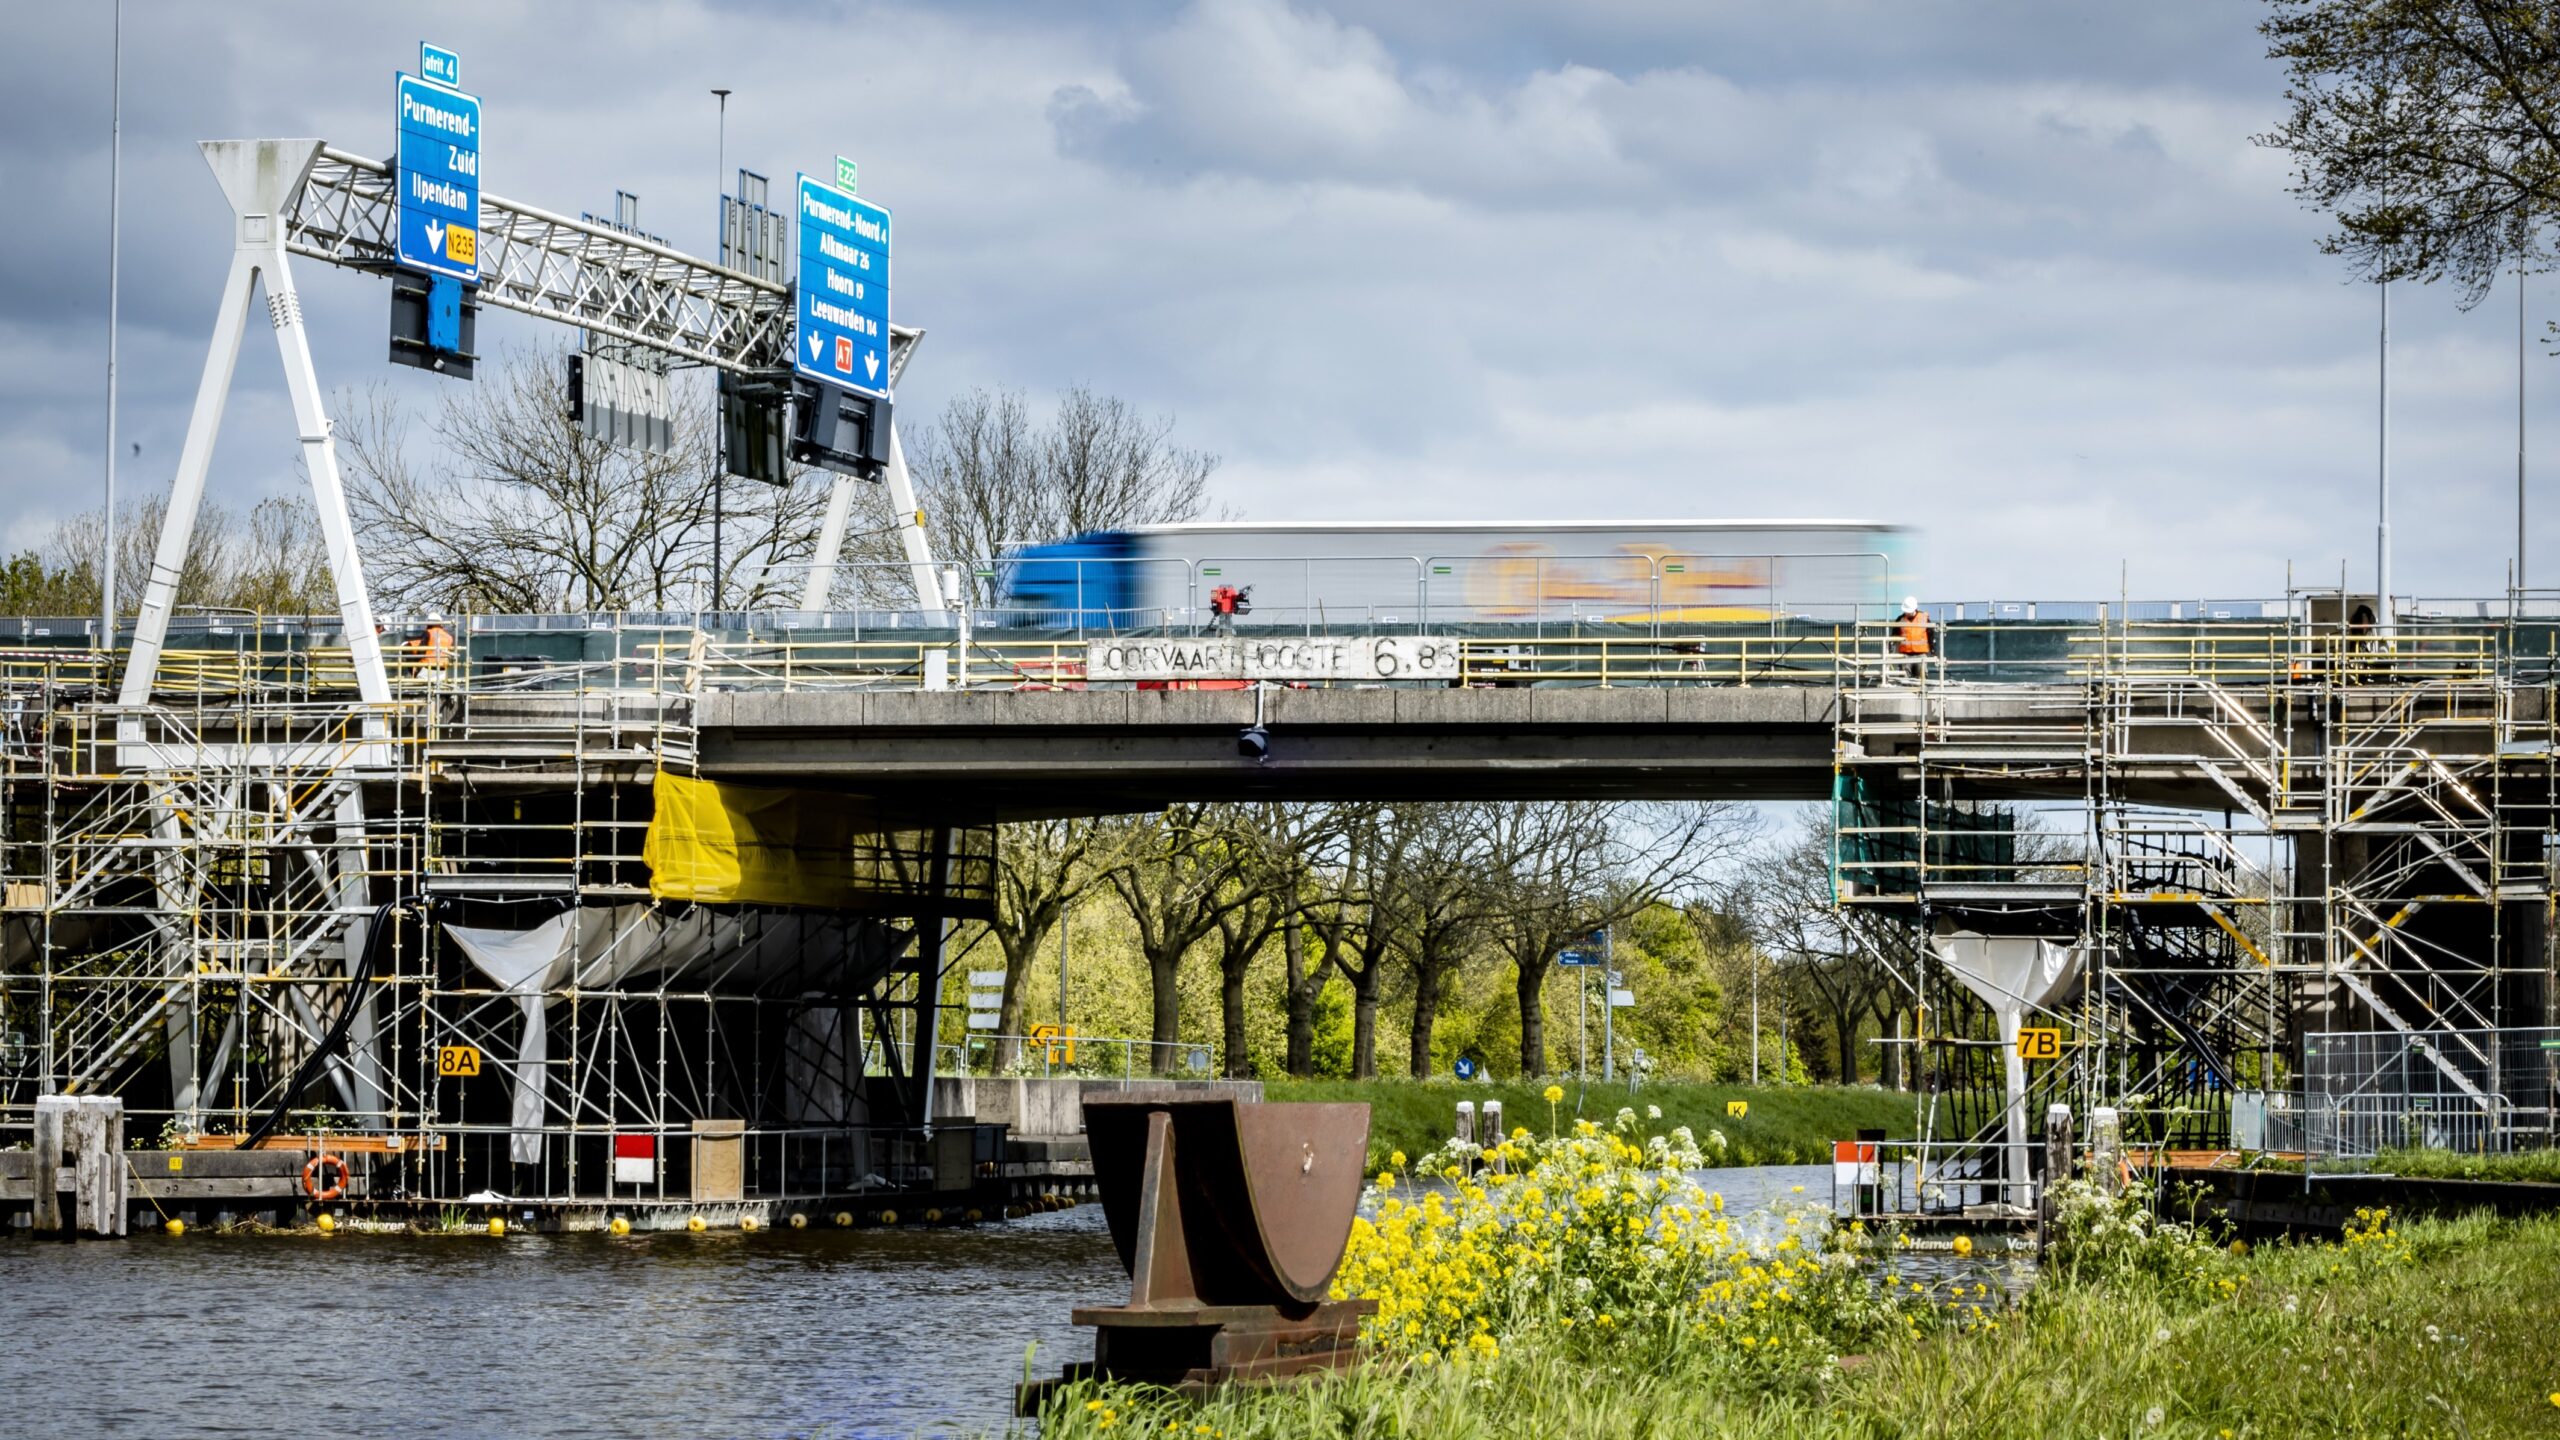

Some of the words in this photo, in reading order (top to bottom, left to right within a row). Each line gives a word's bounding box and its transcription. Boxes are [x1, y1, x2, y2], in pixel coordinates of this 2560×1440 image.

[425, 54, 444, 75] afrit
[446, 60, 455, 80] 4
[404, 92, 476, 137] Purmerend-
[448, 145, 476, 177] Zuid
[837, 162, 856, 188] E22
[413, 172, 468, 211] Ilpendam
[803, 191, 881, 243] Purmerend-Noord
[880, 228, 888, 245] 4
[447, 229, 475, 258] N235
[819, 232, 859, 267] Alkmaar
[860, 253, 870, 271] 26
[827, 267, 854, 298] Hoorn
[855, 283, 864, 300] 19
[811, 293, 865, 334] Leeuwarden
[866, 318, 878, 337] 114
[837, 344, 851, 366] A7
[1374, 638, 1456, 677] 6,85
[2020, 1032, 2056, 1055] 7B
[442, 1050, 476, 1072] 8A
[1733, 1105, 1743, 1118] K
